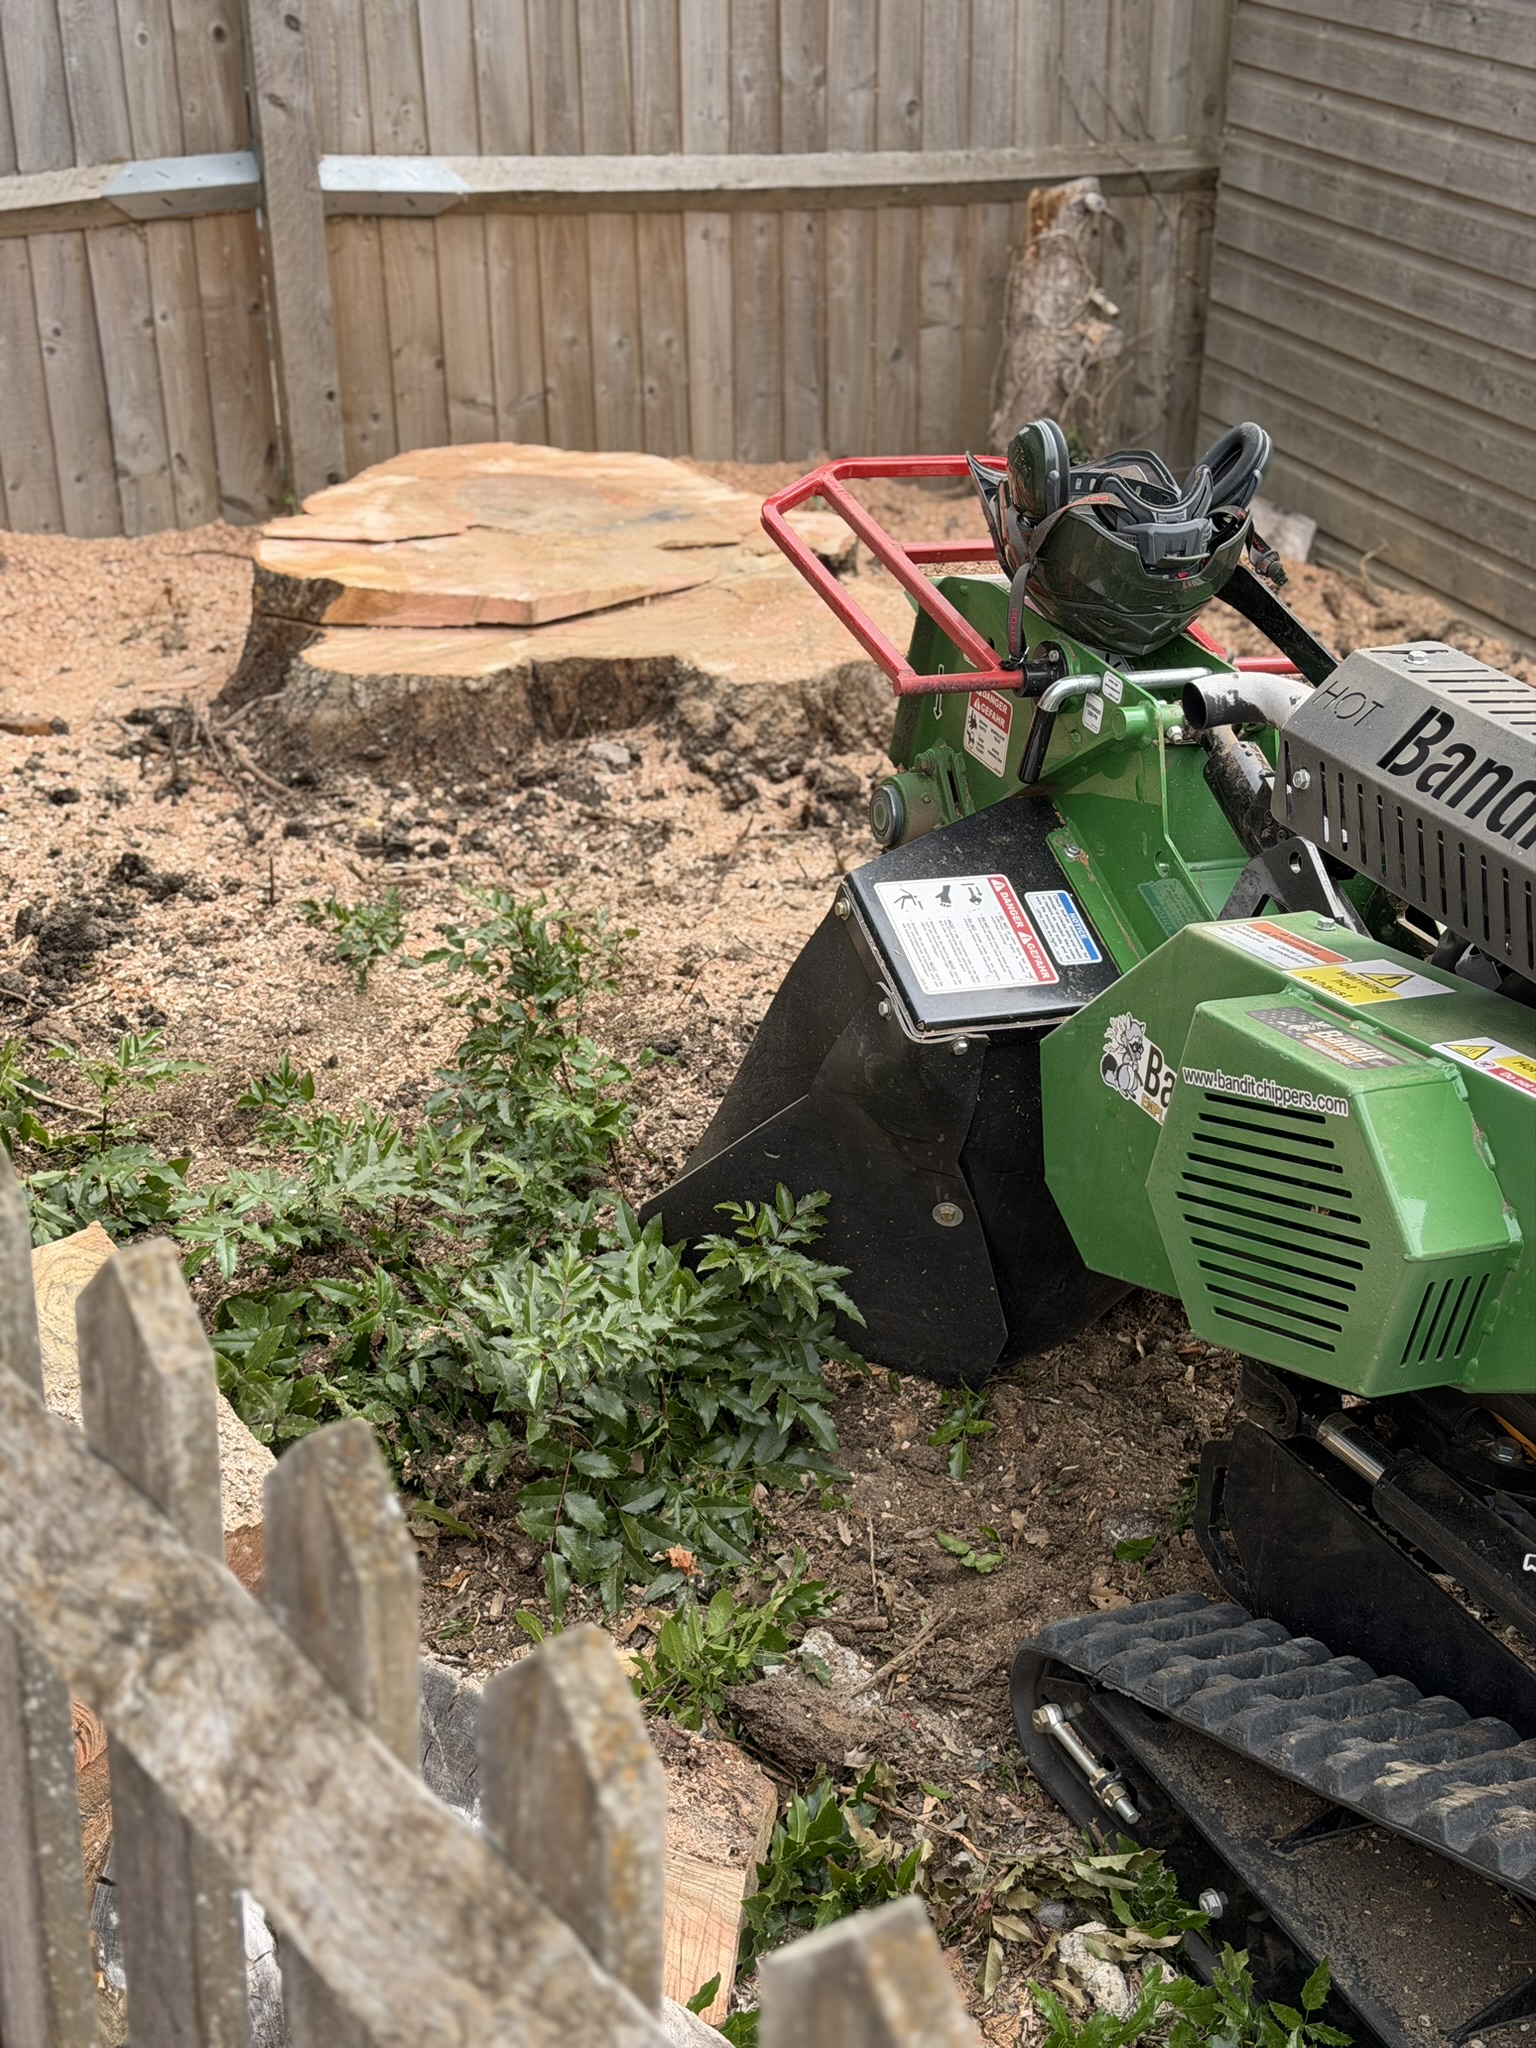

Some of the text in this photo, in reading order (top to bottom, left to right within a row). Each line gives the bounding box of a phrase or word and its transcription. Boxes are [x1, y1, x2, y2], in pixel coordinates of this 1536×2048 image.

[981, 689, 1008, 715] DANGER
[1312, 680, 1385, 727] HOT
[980, 705, 1006, 729] GEFAHR
[999, 891, 1025, 929] DANGER
[1026, 942, 1050, 980] GEFAHR
[1068, 912, 1088, 940] NOTICE
[1301, 975, 1354, 998] exhaust
[1331, 979, 1358, 990] hot
[1336, 970, 1388, 994] Warning
[1312, 1030, 1387, 1061] Bandit
[1183, 1068, 1348, 1115] www.banditchippers.com
